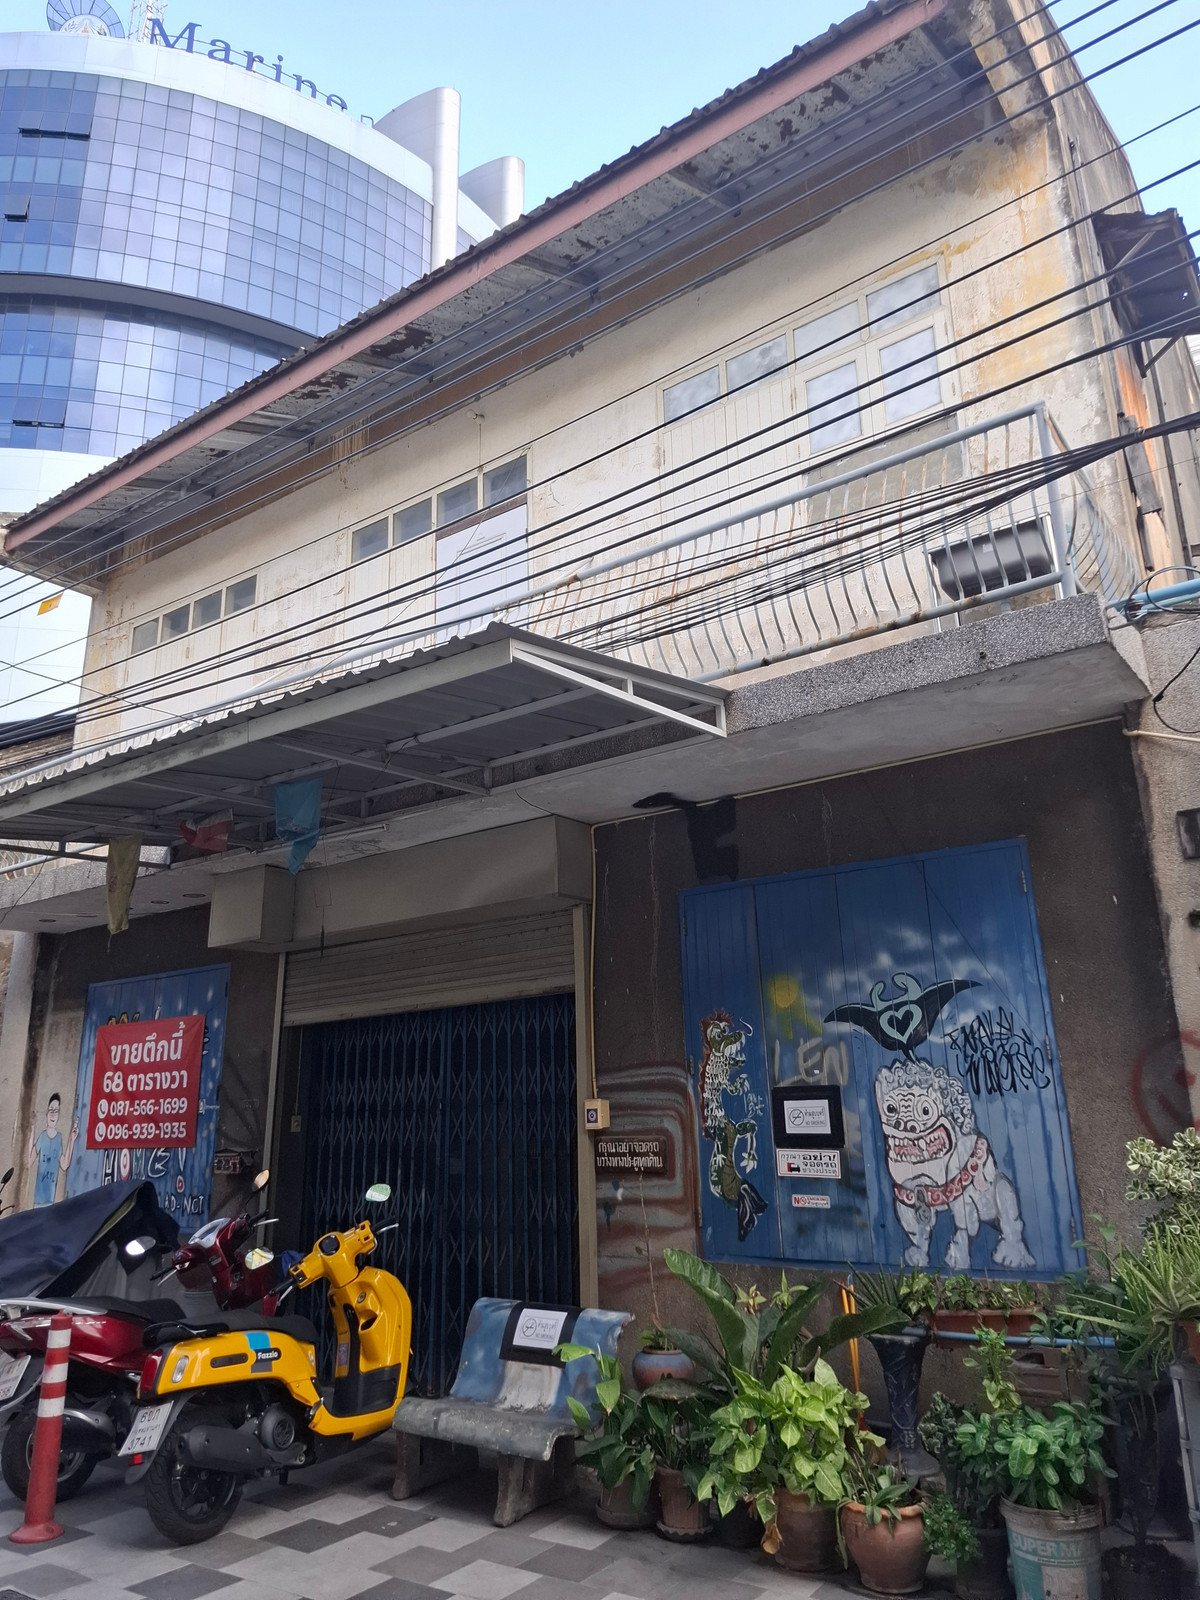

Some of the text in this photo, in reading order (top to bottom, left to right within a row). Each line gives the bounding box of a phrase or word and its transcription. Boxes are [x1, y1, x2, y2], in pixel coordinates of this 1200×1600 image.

[148, 18, 348, 112] Marine
[111, 1021, 186, 1065] ขายตึกนี้
[103, 1070, 188, 1093] 68 ตารางวา
[109, 1097, 188, 1117] 081-566-1699
[107, 1121, 187, 1140] 096-939-1935
[257, 1350, 279, 1360] Fazzio
[1012, 1533, 1057, 1557] SUPER
